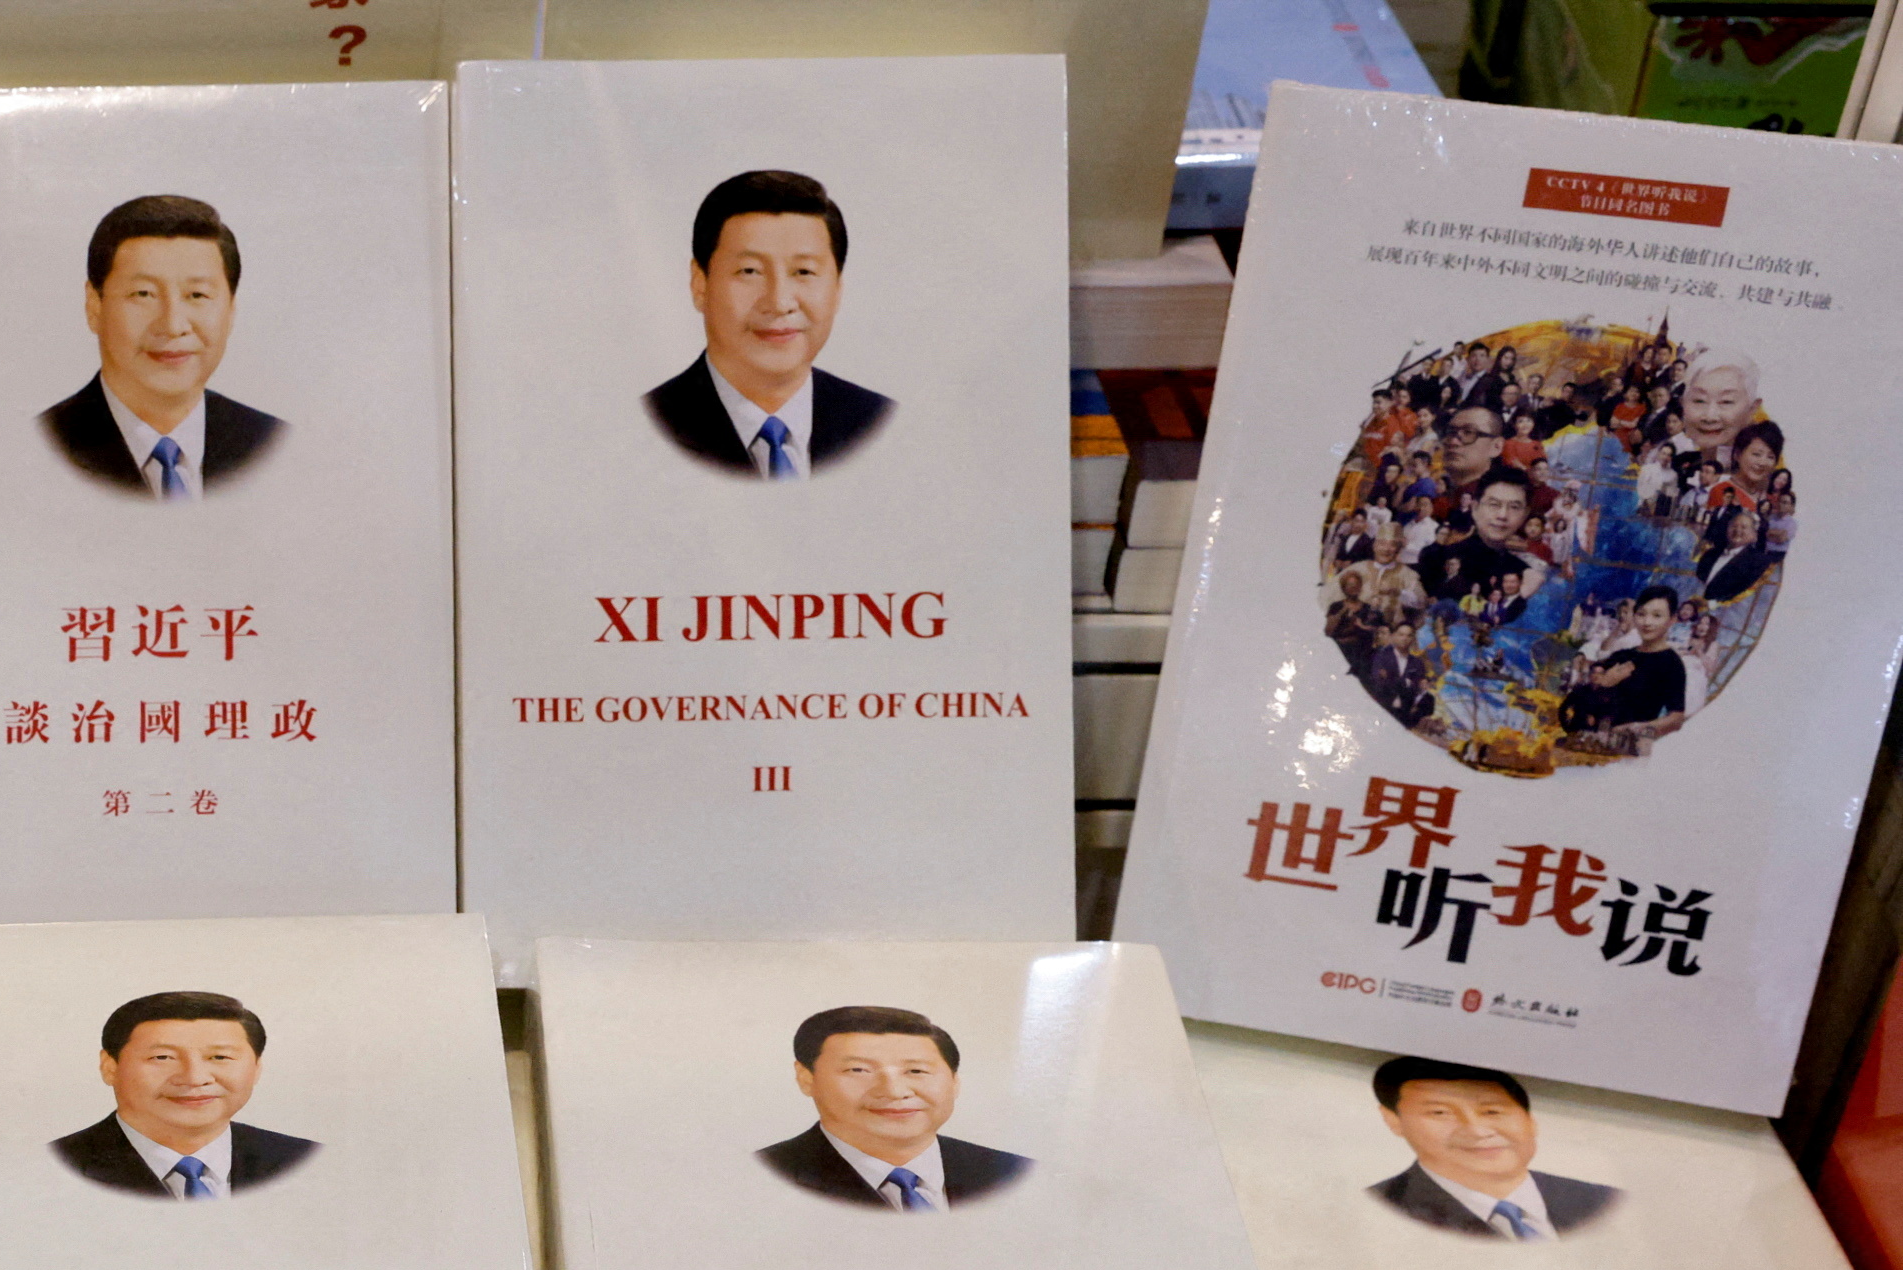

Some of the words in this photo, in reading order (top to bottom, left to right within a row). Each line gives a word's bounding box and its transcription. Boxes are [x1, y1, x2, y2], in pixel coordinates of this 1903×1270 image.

[59, 603, 261, 663] 習近平
[595, 596, 663, 644] XI
[681, 590, 948, 643] JINPING
[4, 698, 319, 744] 談治國理政
[512, 696, 586, 724] THE
[595, 693, 848, 723] GOVERNANCE
[858, 692, 907, 720] OF
[914, 691, 1030, 719] CHINA
[752, 765, 794, 792] III
[103, 788, 219, 817] 第二卷
[1243, 776, 1715, 976] 世界听我说
